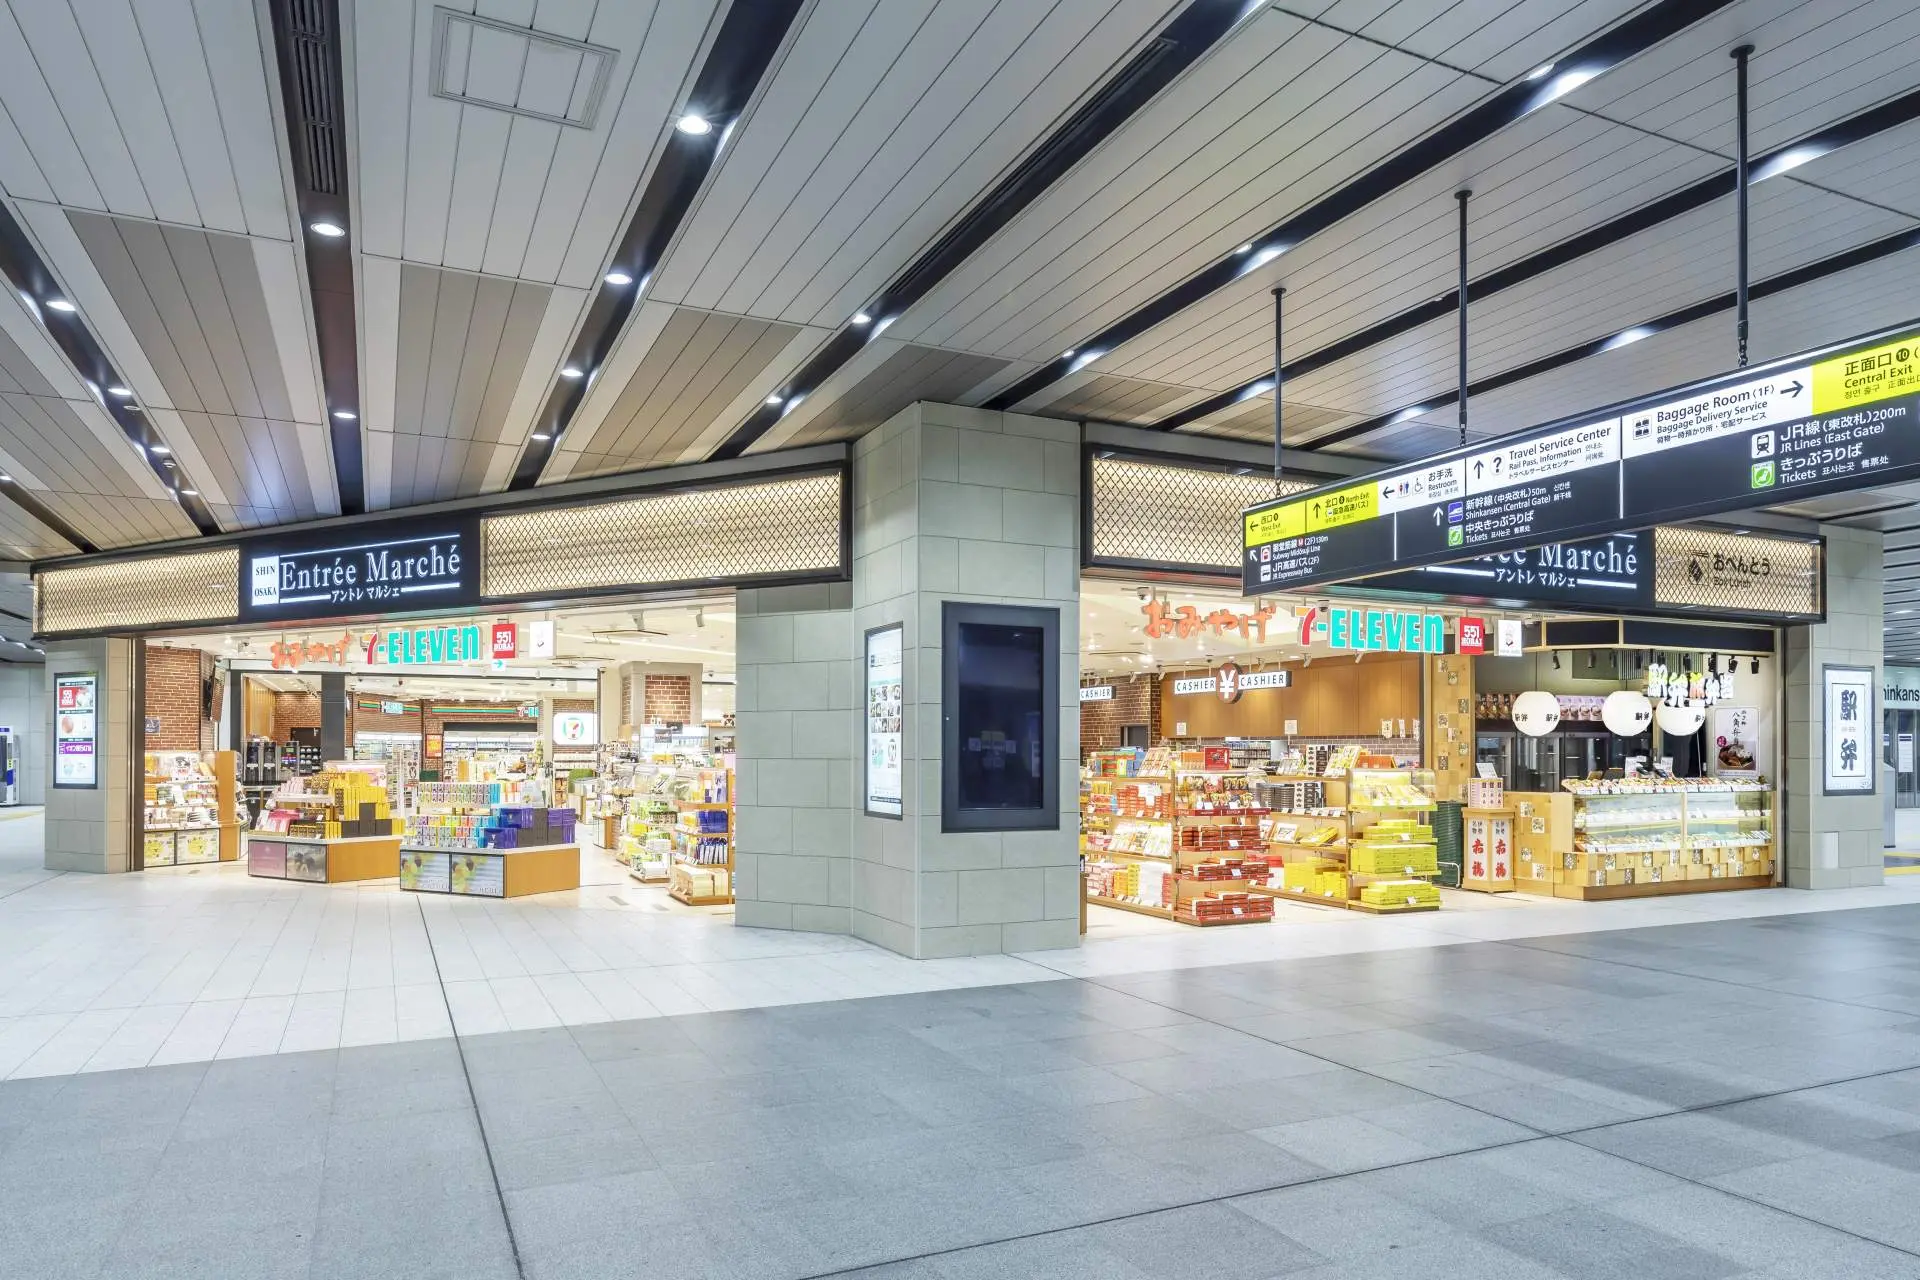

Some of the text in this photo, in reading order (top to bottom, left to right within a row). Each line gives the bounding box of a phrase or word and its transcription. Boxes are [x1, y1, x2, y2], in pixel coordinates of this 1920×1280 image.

[1845, 353, 1892, 377] 正面口
[1844, 364, 1913, 388] Central Exit
[1657, 401, 1709, 423] Baggage
[1713, 391, 1750, 408] Room
[1657, 401, 1768, 434] Baggage Delivery Service
[1509, 427, 1611, 461] Travel Service Center
[1780, 423, 1885, 454] JR Lines (East Gate)
[1509, 460, 1521, 470] Rail
[1540, 447, 1582, 462] Information
[1780, 442, 1863, 471] きっぷうりば
[1428, 480, 1457, 491] Restroom
[1780, 469, 1817, 484] Tickets
[1466, 494, 1551, 520] Shinkansen (Central Gate)
[1465, 510, 1535, 533] 中央きっぷうりば
[1466, 533, 1488, 544] Tickets
[1273, 551, 1289, 561] Subway
[1538, 540, 1637, 574] Marché
[255, 565, 275, 576] SHIN
[280, 544, 460, 591] Entrée Marché
[1304, 566, 1313, 574] Bus
[1496, 568, 1576, 588] アントレ マルシェ
[254, 586, 277, 597] OSAKA
[331, 585, 400, 603] アントレ マルシェ
[1141, 599, 1277, 643] おみやげ
[1463, 625, 1480, 638] 551
[496, 631, 512, 644] 551
[1081, 688, 1111, 699] CASHIER
[1176, 680, 1215, 692] CASHIER
[1240, 674, 1284, 687] CASHIER
